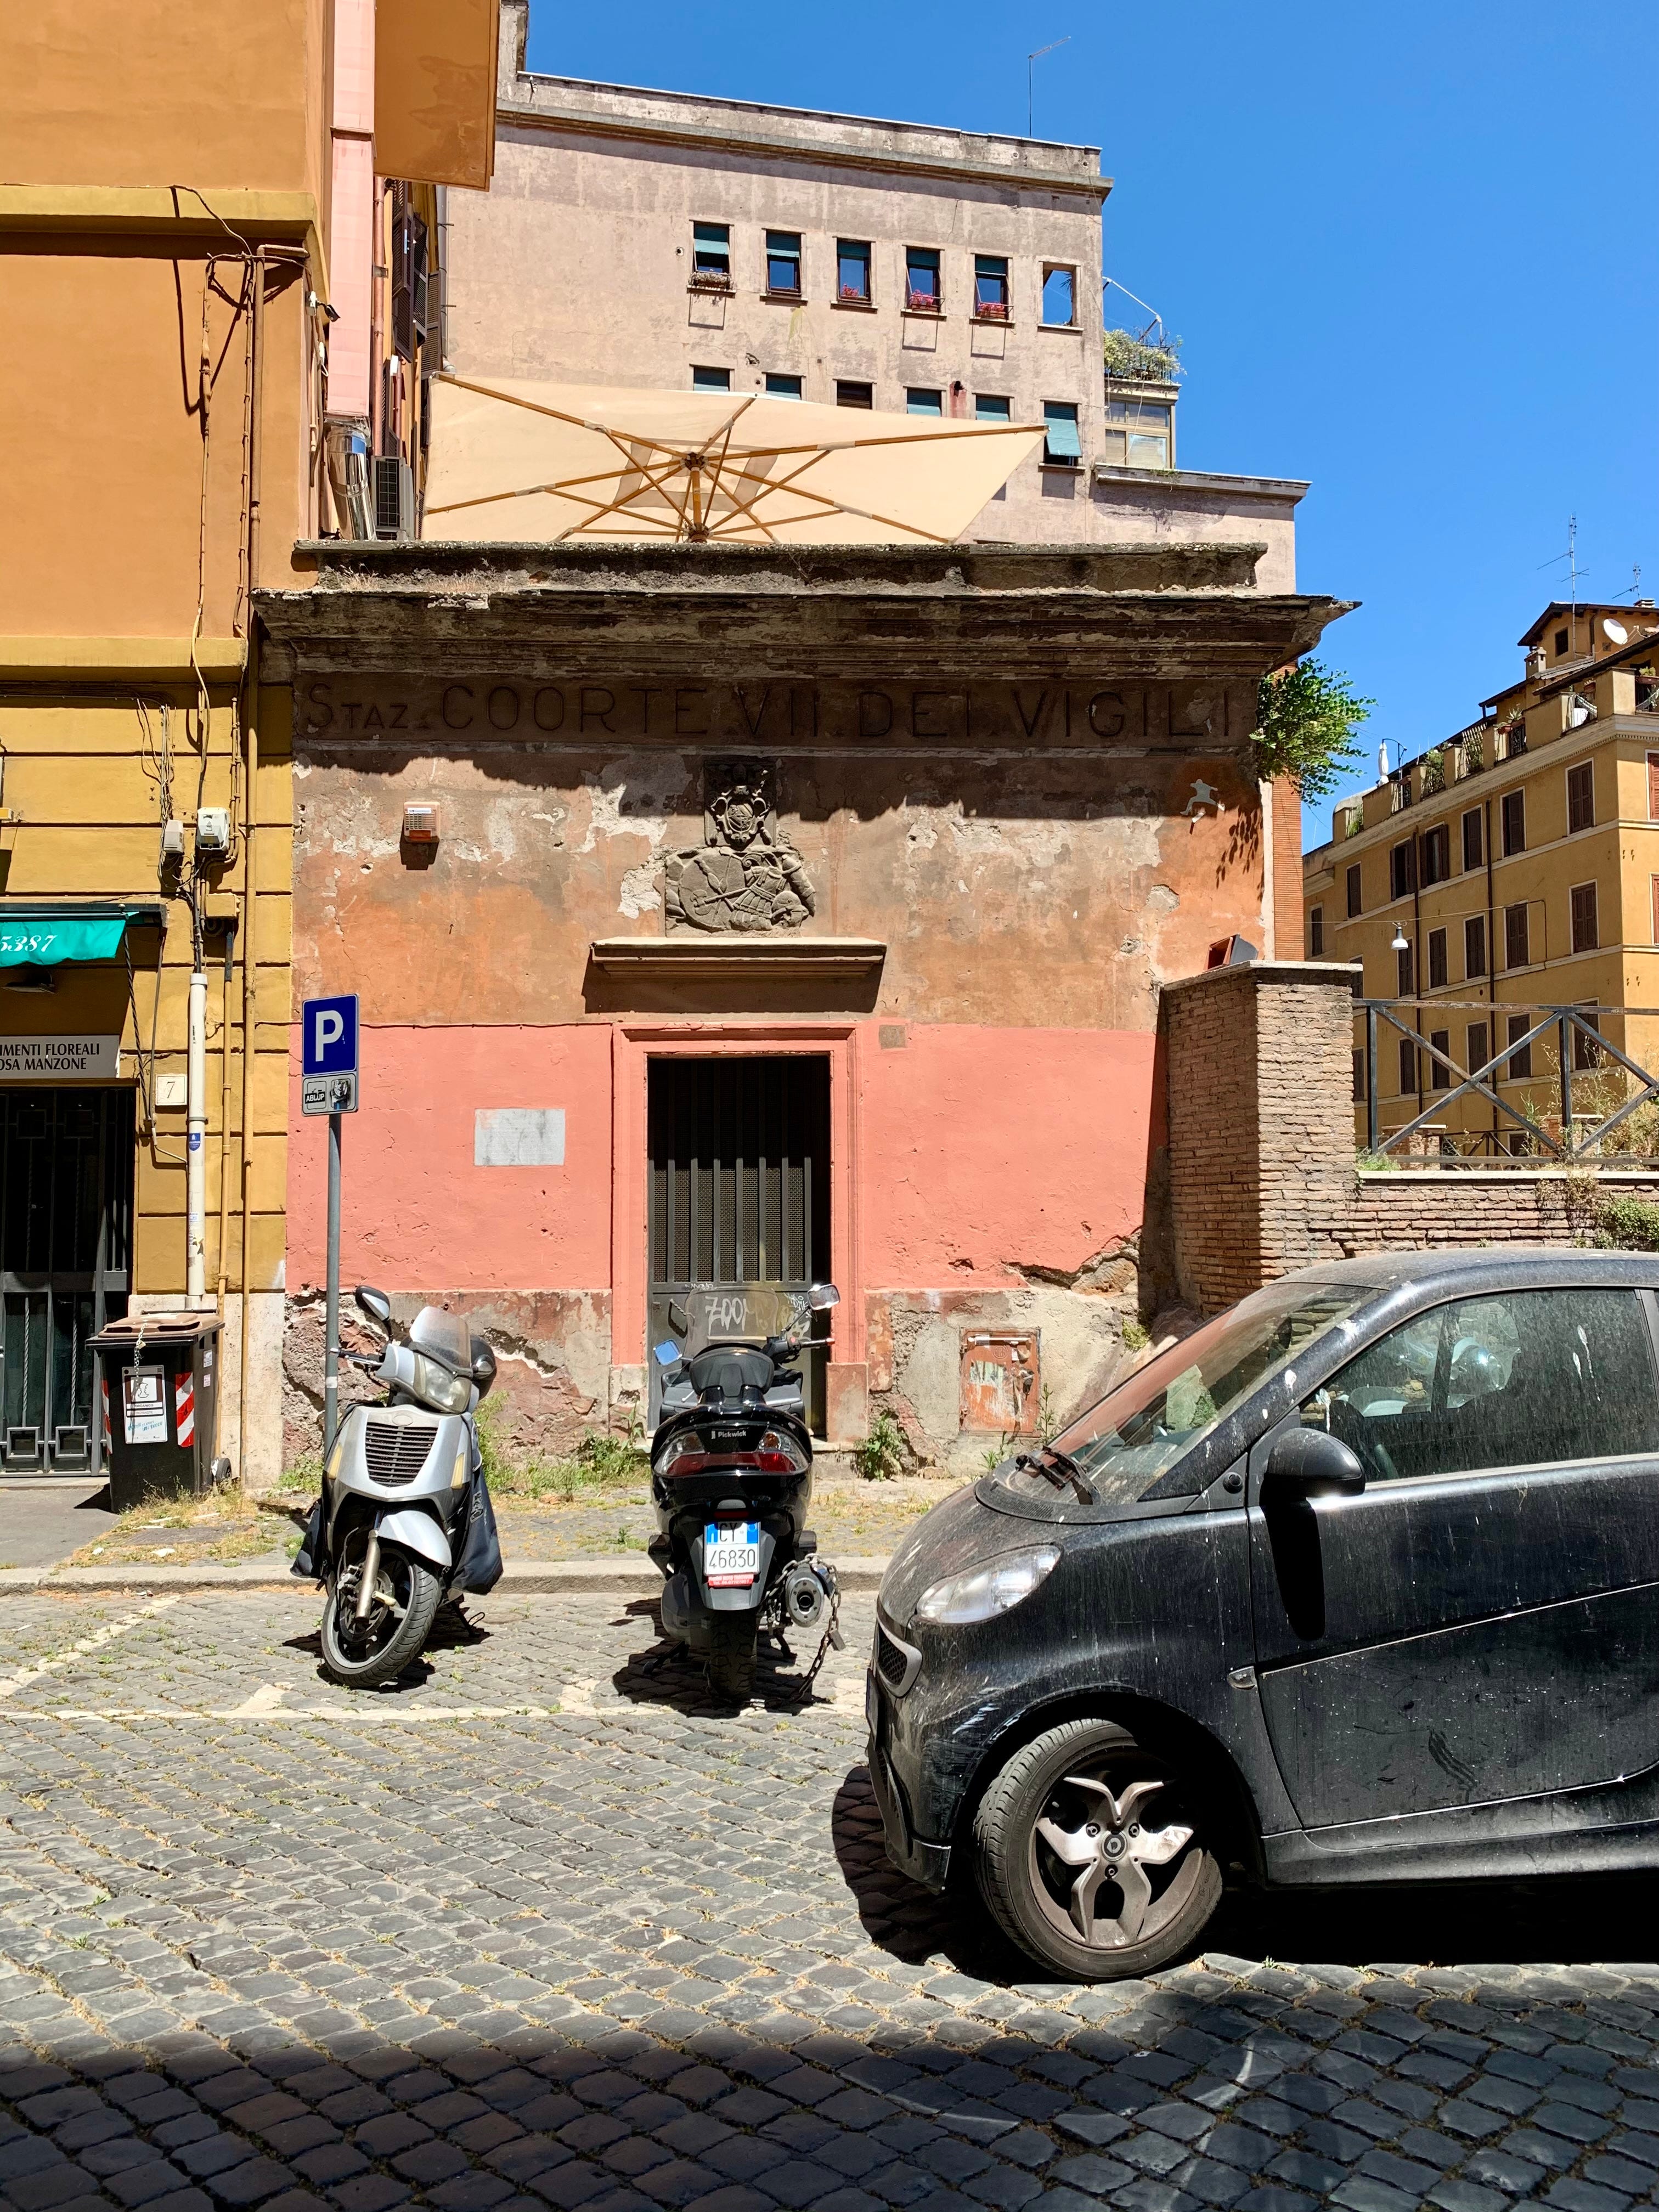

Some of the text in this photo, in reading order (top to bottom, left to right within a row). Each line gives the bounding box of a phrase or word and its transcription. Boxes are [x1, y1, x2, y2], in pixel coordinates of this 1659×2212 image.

[442, 685, 708, 734] COORTE
[1012, 689, 1229, 737] VIGILI
[315, 1010, 344, 1062] P
[46, 1043, 100, 1056] FLOREALI
[24, 1058, 87, 1070] MANZONE
[166, 1081, 176, 1098] 7
[719, 1522, 737, 1542] CY
[709, 1549, 755, 1568] 46830
